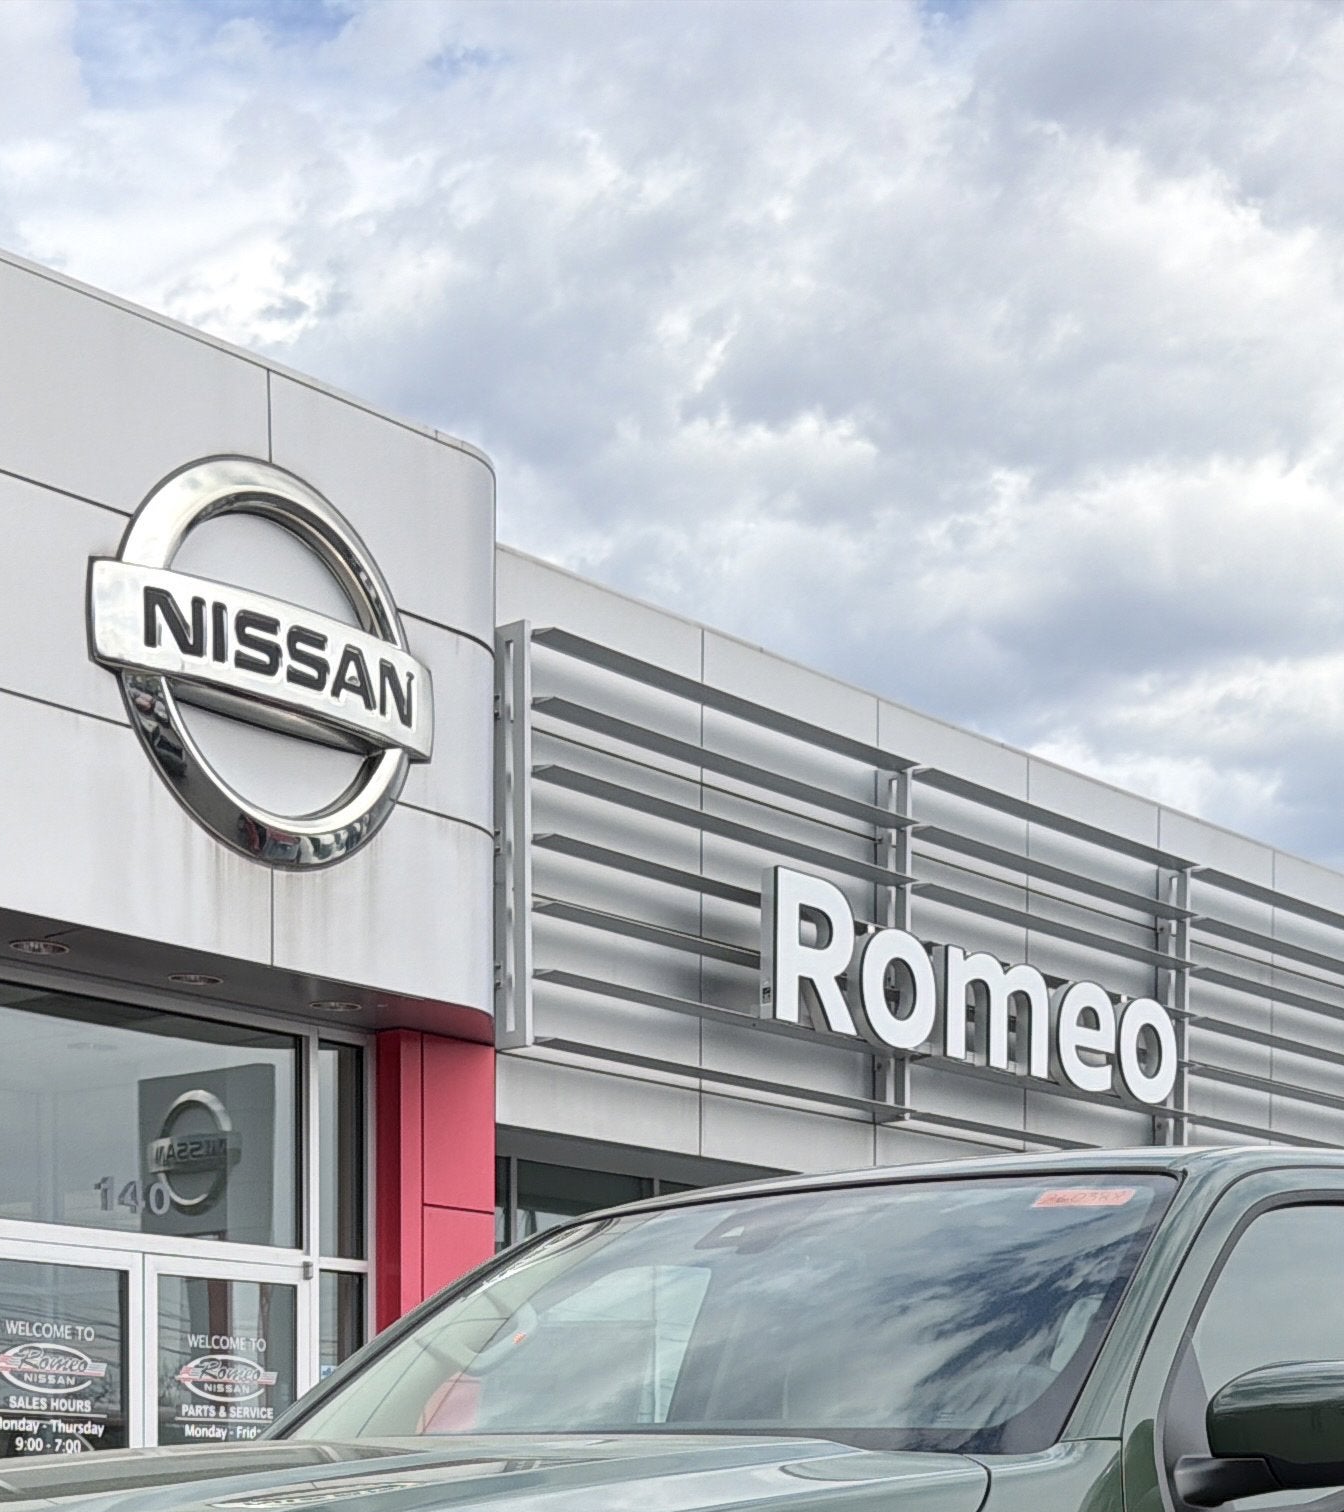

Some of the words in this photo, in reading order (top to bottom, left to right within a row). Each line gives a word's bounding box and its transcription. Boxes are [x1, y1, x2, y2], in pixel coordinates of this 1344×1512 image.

[142, 584, 415, 729] NISSAN
[773, 864, 1178, 1105] Romeo
[94, 1175, 171, 1216] 140
[5, 1320, 74, 1338] WELCOME
[76, 1326, 95, 1341] TO
[187, 1334, 249, 1351] WELCOME
[250, 1338, 267, 1352] TO
[12, 1345, 89, 1373] Romeo
[198, 1358, 261, 1381] Romeo
[23, 1373, 76, 1386] NISSAN
[203, 1383, 250, 1394] NISSAN
[8, 1396, 48, 1411] SALES
[50, 1398, 92, 1412] HOURS
[181, 1404, 216, 1417] PARTS
[218, 1405, 227, 1417] &
[229, 1406, 274, 1419] SERVICE
[51, 1419, 105, 1438] Thursday
[184, 1424, 228, 1440] Monday
[236, 1425, 262, 1440] Frid
[15, 1437, 44, 1452] 9:00
[54, 1439, 82, 1455] 7:00
